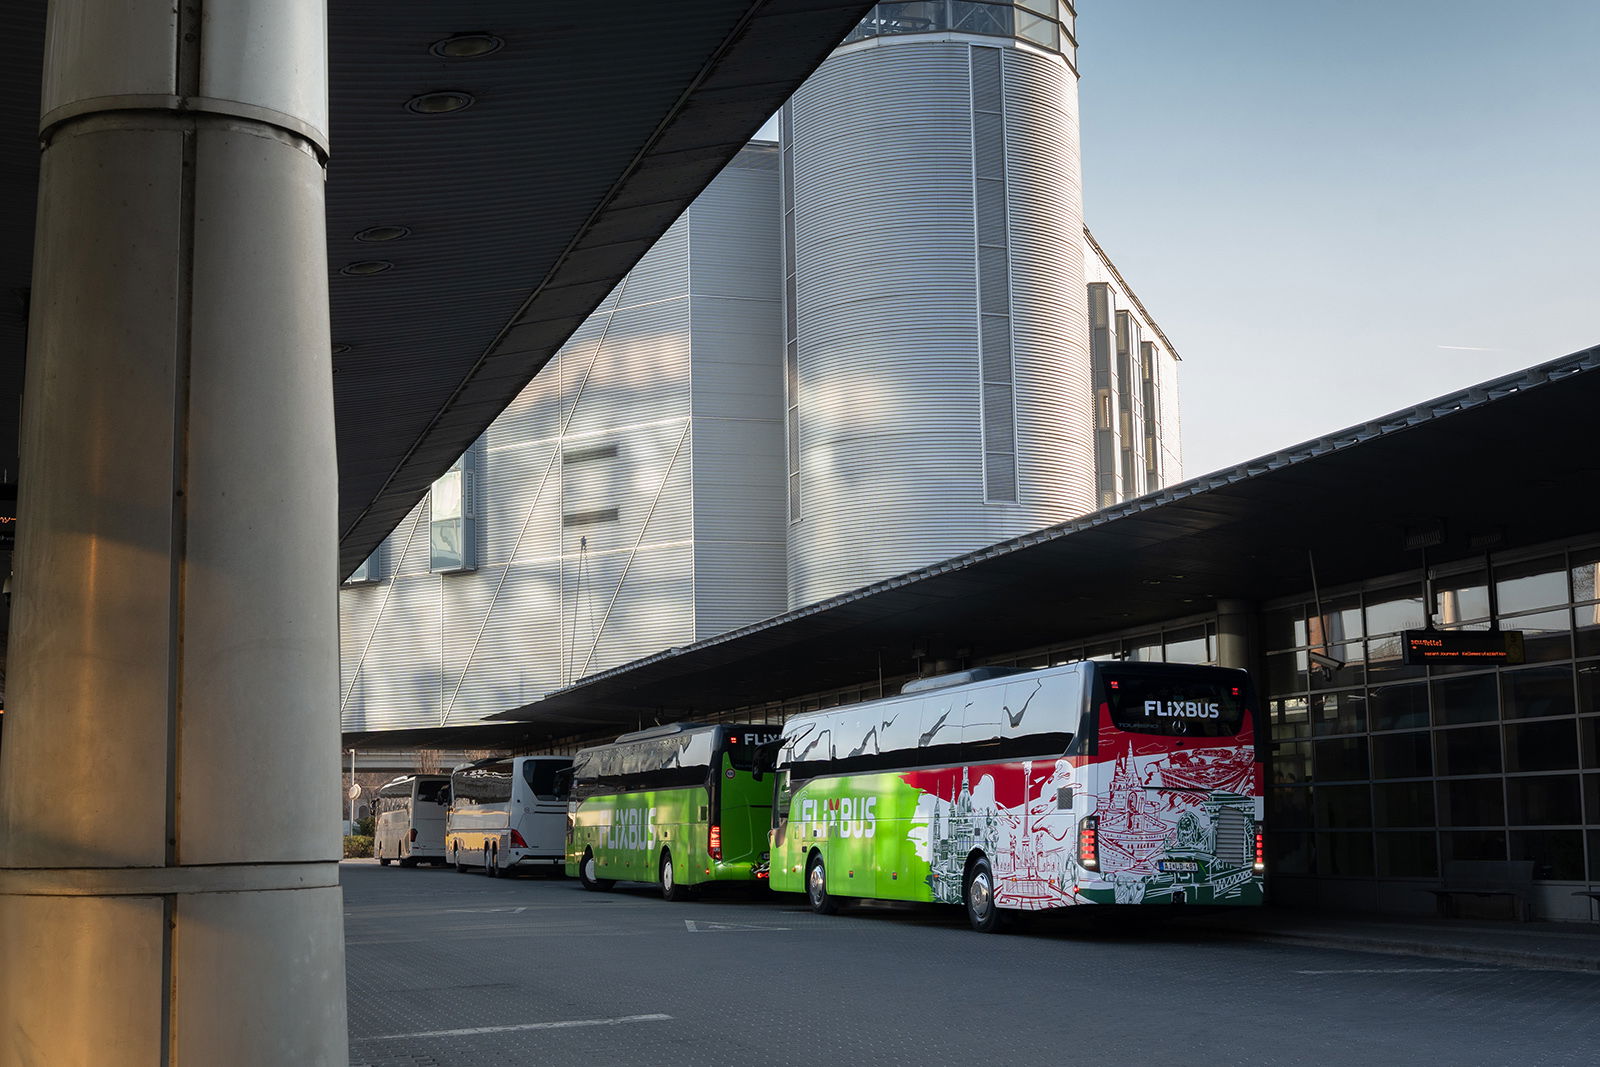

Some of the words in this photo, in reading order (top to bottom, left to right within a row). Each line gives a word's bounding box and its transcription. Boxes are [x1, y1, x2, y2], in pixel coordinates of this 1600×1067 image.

[1144, 700, 1220, 719] FLiXBUS
[599, 807, 657, 850] FLiXBUS
[801, 796, 877, 838] FLiXBUS
